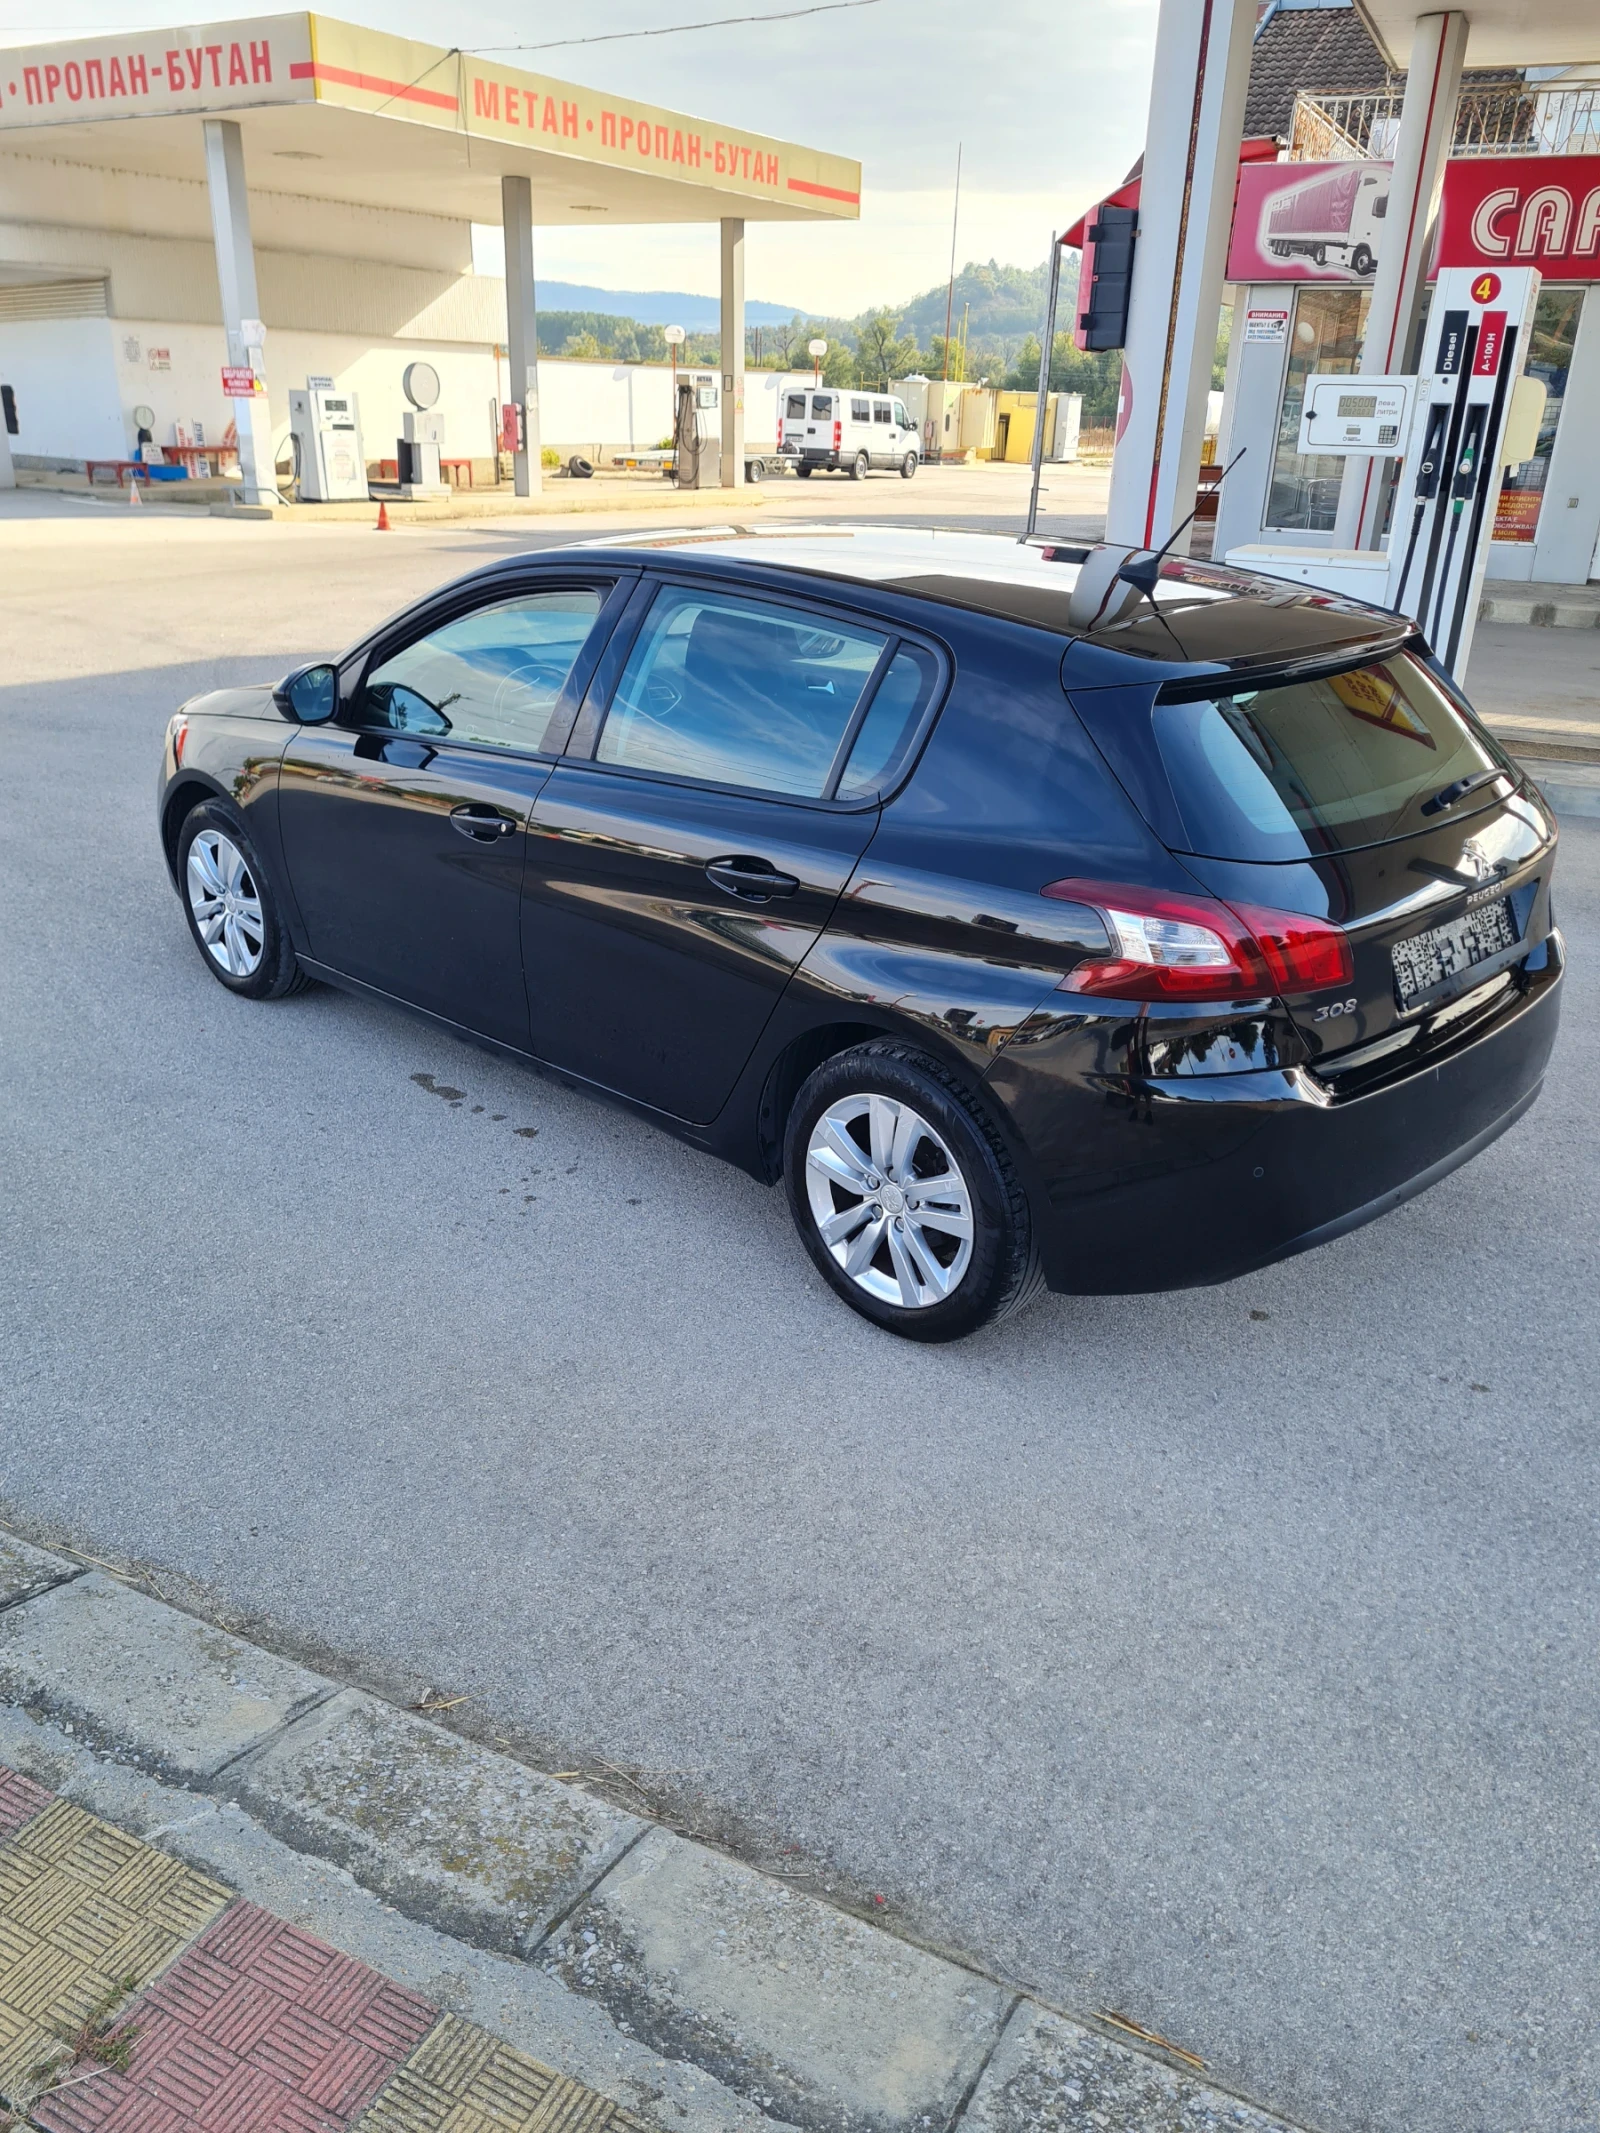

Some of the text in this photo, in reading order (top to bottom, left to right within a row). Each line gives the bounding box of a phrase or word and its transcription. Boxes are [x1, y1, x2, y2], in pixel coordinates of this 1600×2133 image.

[23, 40, 272, 105] ПРОПАН-БУТАН
[474, 78, 779, 186] МЕТАН ПРОПАН-БУТАН
[1476, 277, 1491, 300] 4
[1443, 332, 1458, 371] Diesel
[1467, 880, 1506, 905] PEUGEOT
[1313, 998, 1358, 1022] 308
